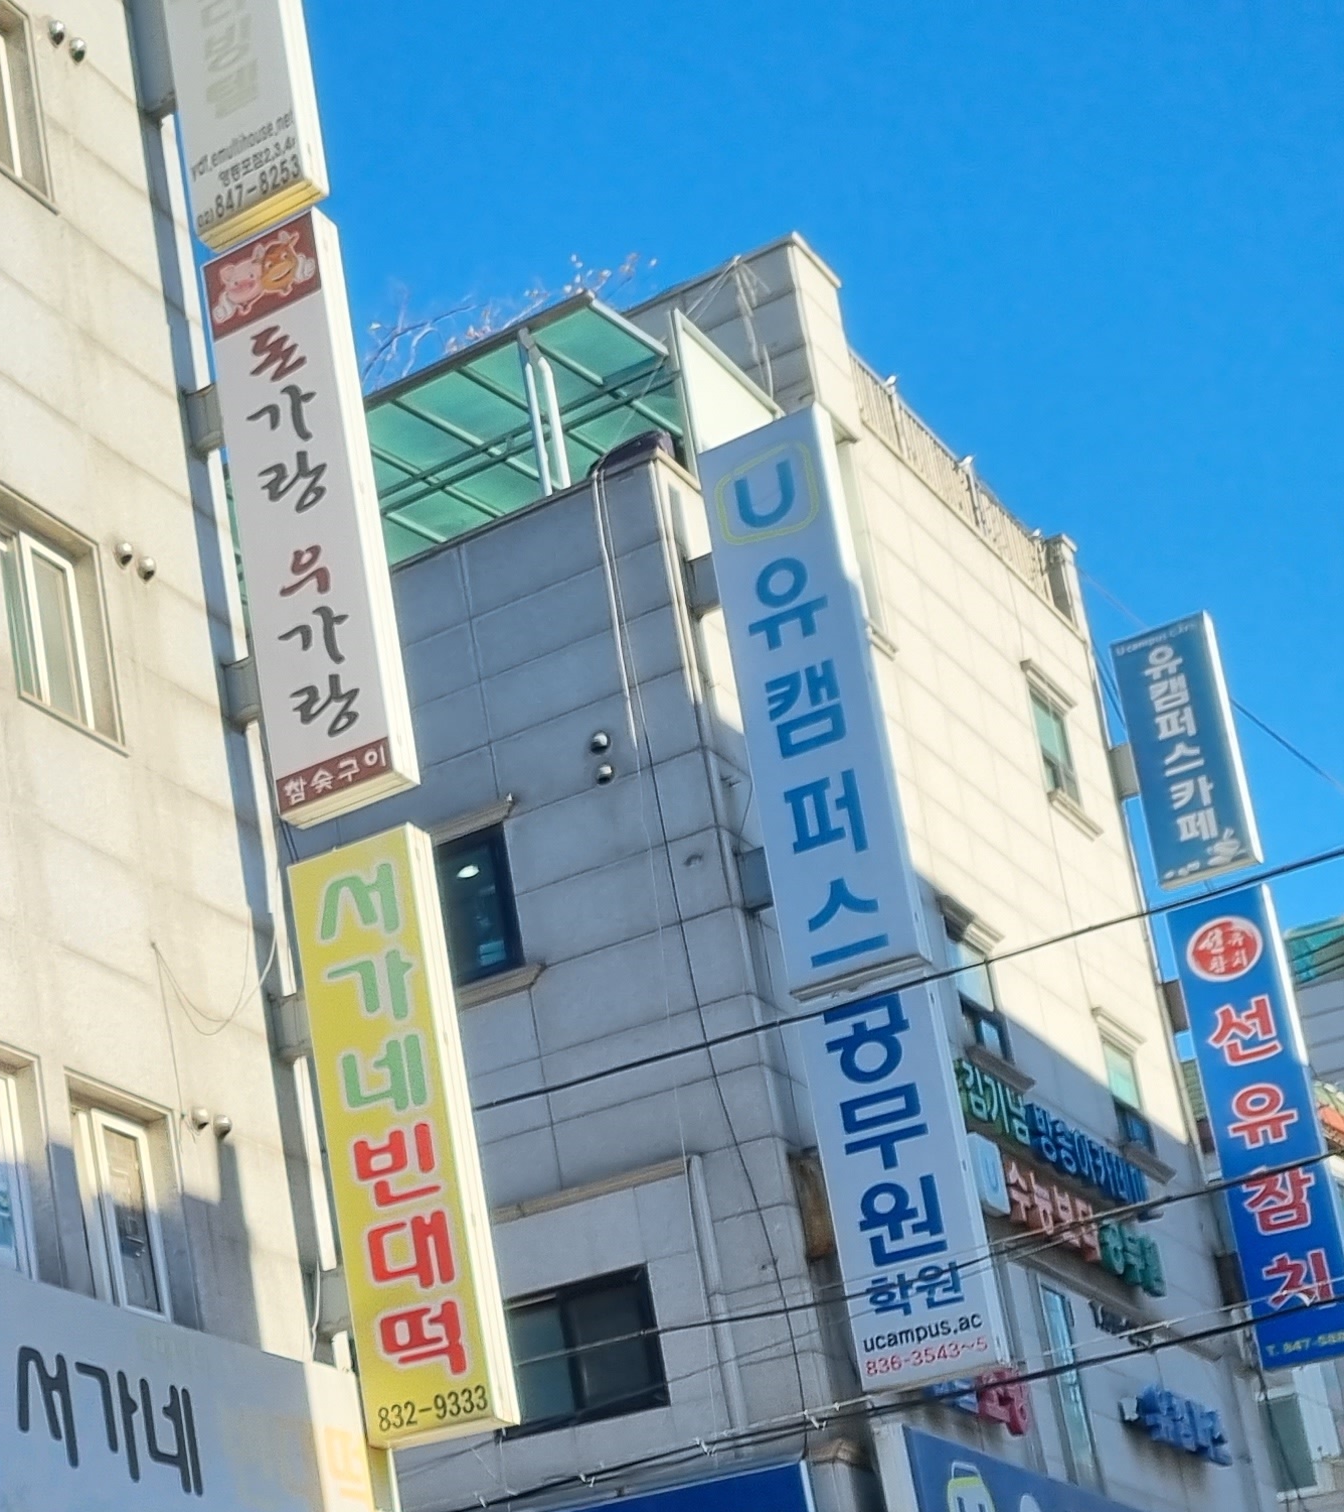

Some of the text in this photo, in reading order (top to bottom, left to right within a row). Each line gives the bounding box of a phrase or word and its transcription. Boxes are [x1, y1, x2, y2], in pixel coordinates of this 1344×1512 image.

[215, 153, 301, 219] 847-8253
[748, 556, 889, 968] 유캠퍼스
[1142, 643, 1219, 843] 유캠퍼스카페
[320, 862, 469, 1374] 서가네 빈대떡
[823, 990, 949, 1267] 공무원
[862, 1311, 983, 1353] ucampus.ac
[865, 1259, 965, 1317] 학원
[16, 1345, 203, 1497] 서가네
[377, 1384, 490, 1433] 832-9333
